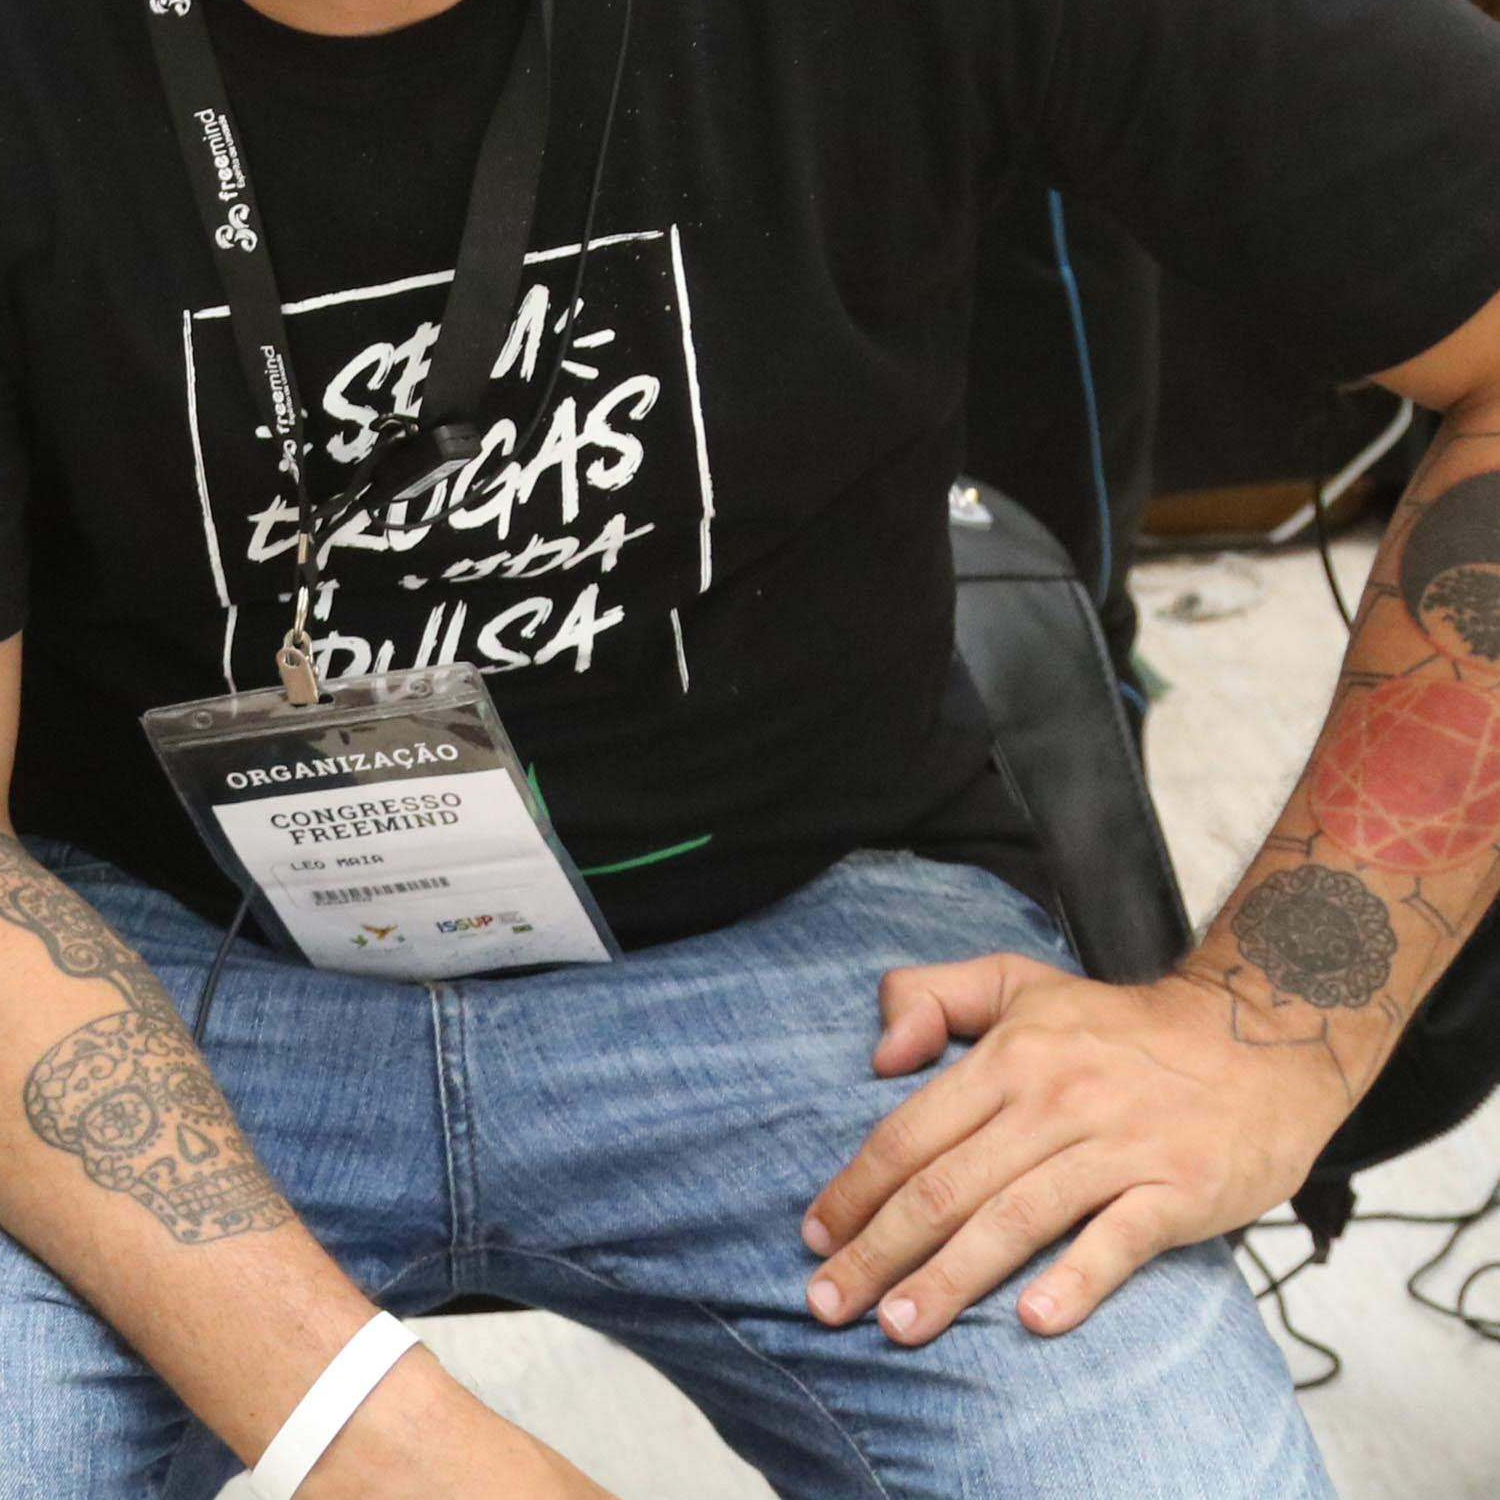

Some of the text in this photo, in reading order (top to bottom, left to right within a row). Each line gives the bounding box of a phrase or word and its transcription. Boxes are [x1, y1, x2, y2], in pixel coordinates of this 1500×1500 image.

[193, 108, 239, 202] freemind
[260, 345, 291, 435] freemind
[226, 743, 459, 789] ORGANIZAÇÃO
[270, 792, 463, 830] CONGRESSO
[288, 810, 460, 846] FREEMIND
[290, 854, 385, 871] LEO MAIA
[436, 914, 494, 934] ISSUP
